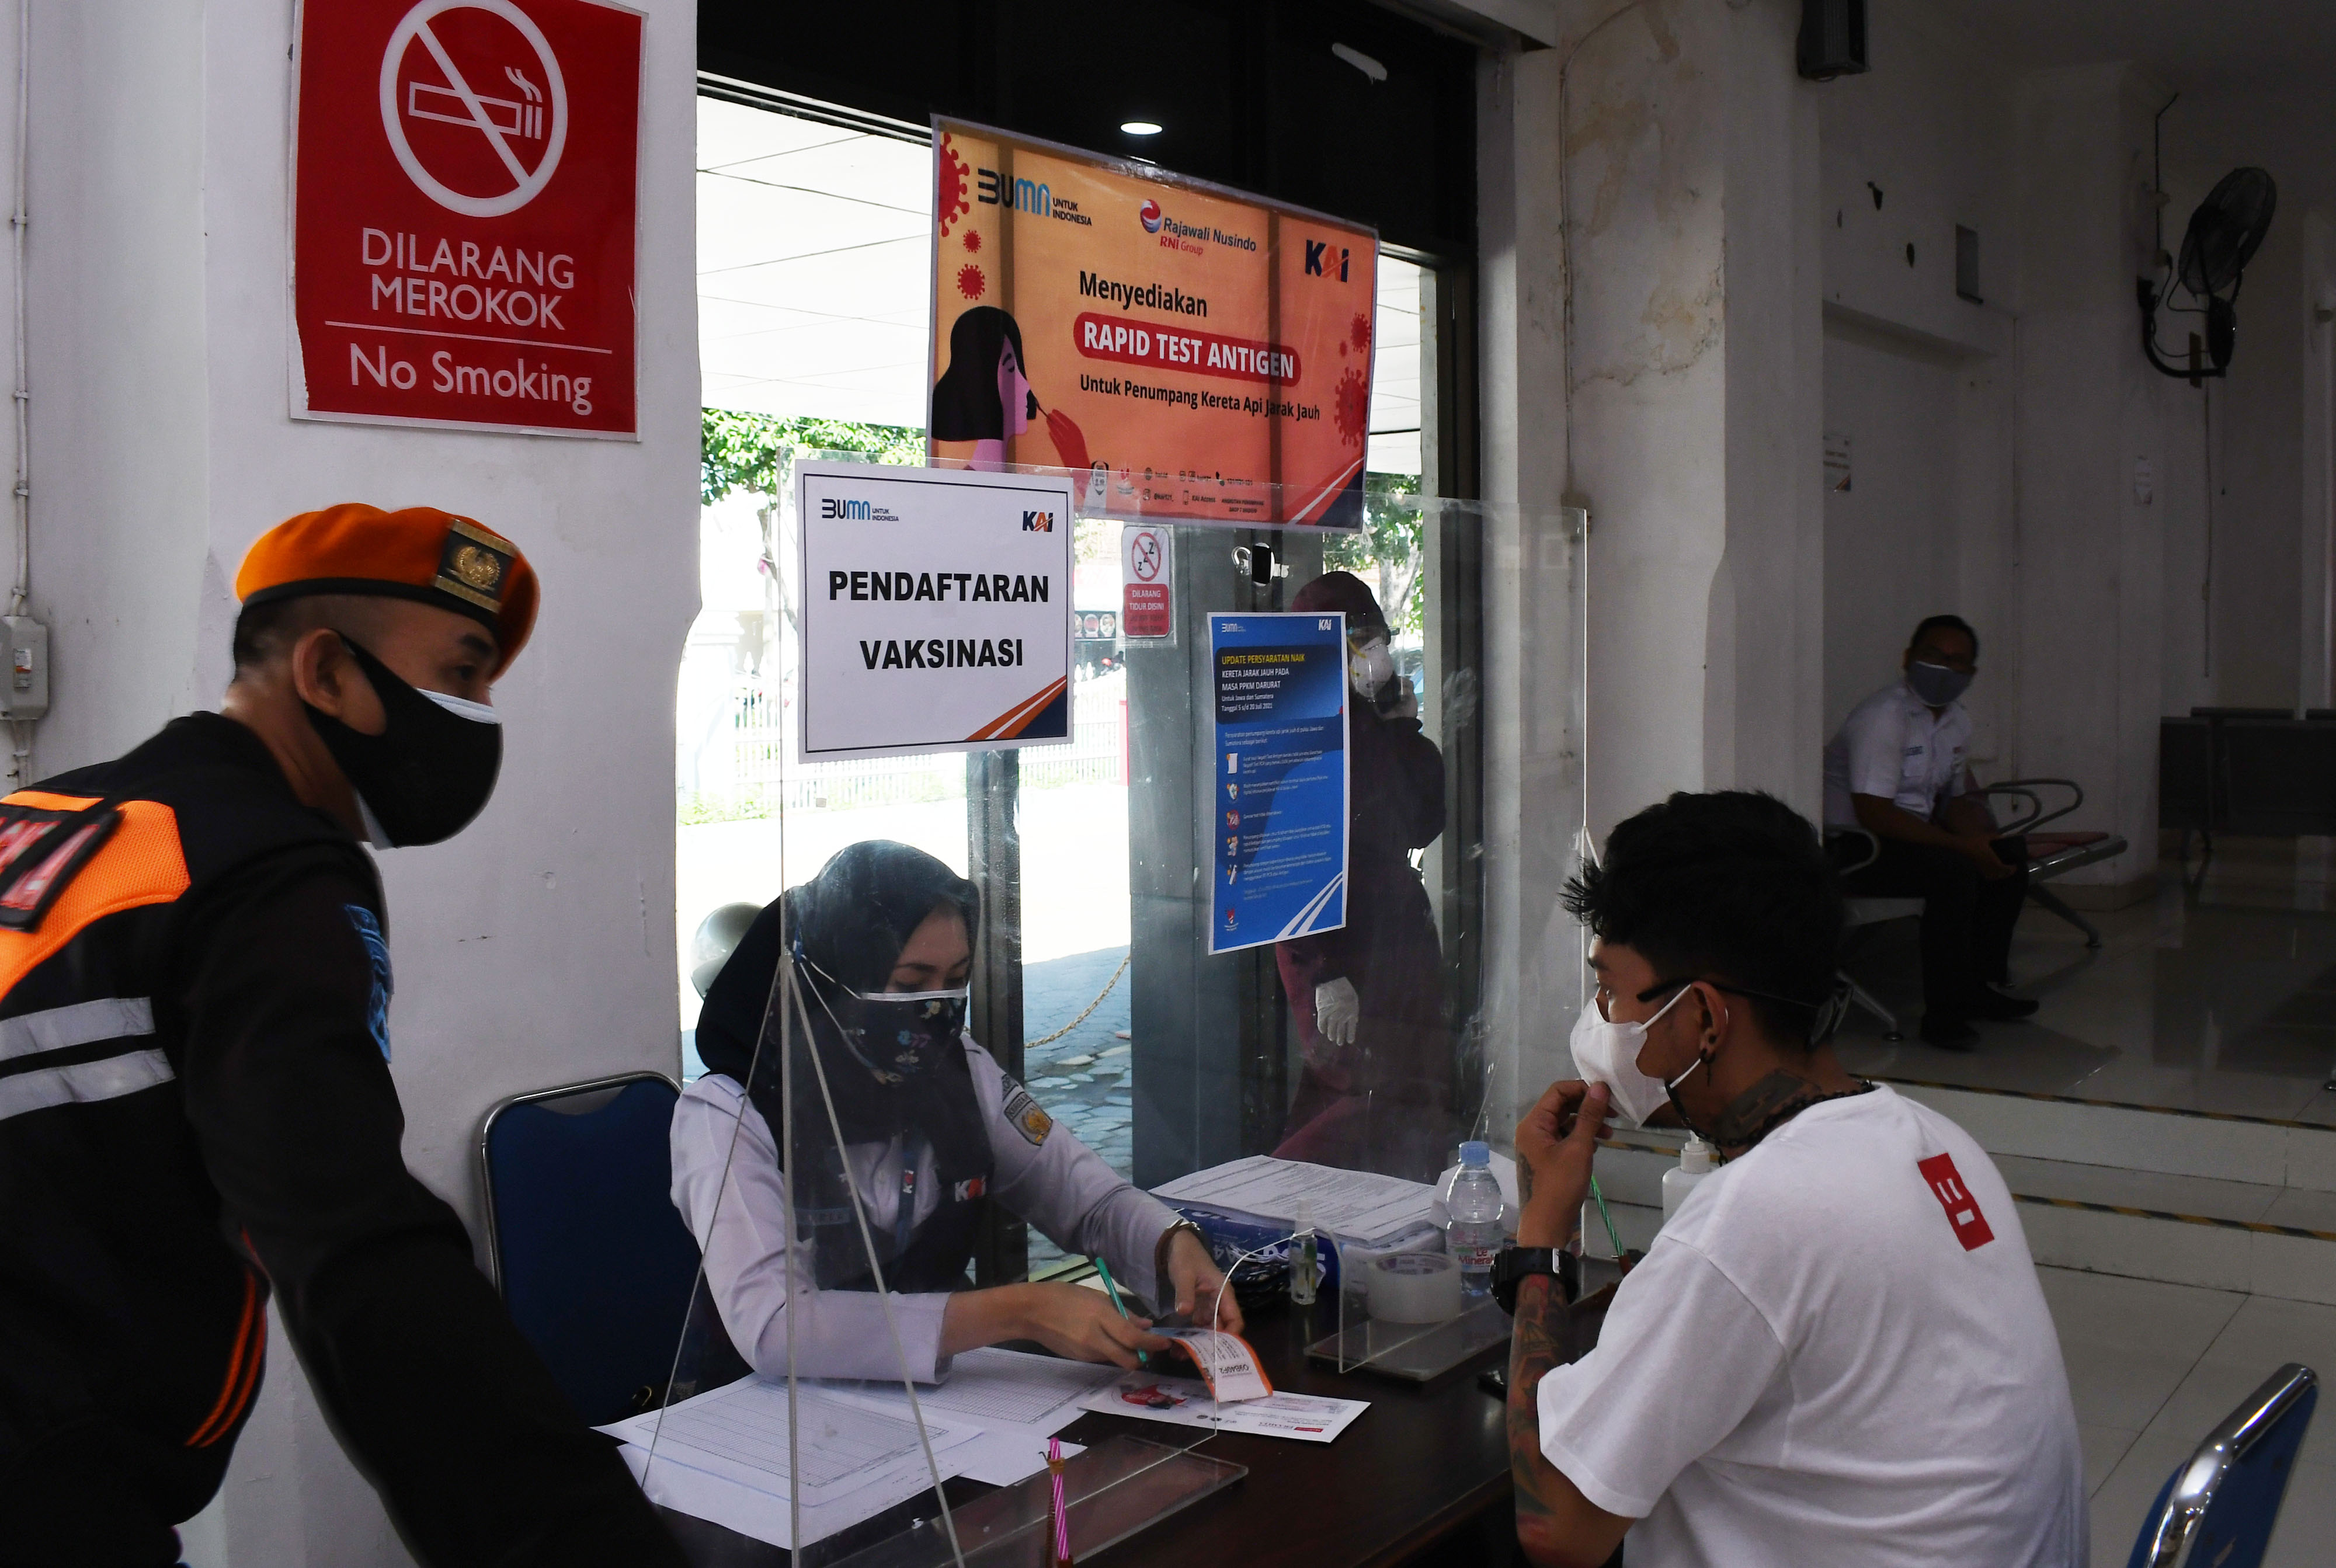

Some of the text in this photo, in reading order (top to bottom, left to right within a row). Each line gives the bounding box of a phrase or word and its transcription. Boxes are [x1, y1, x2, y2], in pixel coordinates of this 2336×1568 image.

[978, 168, 1050, 217] BUMN
[1052, 197, 1078, 211] UNTUK
[1052, 209, 1092, 226] INDONESIA
[1163, 217, 1257, 252] Rajawali Nusindo
[361, 227, 575, 290] DILARANG
[1181, 241, 1204, 256] Group
[1305, 239, 1349, 283] KAI
[371, 273, 565, 331] MEROKOK
[1079, 270, 1208, 317] Menyediakan
[1083, 321, 1294, 379] RAPID TEST ANTIGEN
[350, 343, 593, 416] No Smoking
[1080, 374, 1320, 420] Untuk Penumpang Kereta Api Jarak Jauh
[822, 499, 871, 520] BUMN
[1022, 510, 1054, 532] KAI
[828, 570, 1049, 603] PENDAFTARAN
[1132, 590, 1161, 598] DILARANG
[1148, 602, 1164, 610] DISINI
[1318, 619, 1332, 631] KAI
[859, 638, 1023, 670] VAKSINASI
[1222, 653, 1305, 665] UPDATE PERSYARATAN NAIK
[1222, 670, 1242, 678] KERETA
[1242, 669, 1259, 677] JARAK
[1260, 668, 1274, 676] JAUH
[1222, 680, 1281, 691] MASA PPKM DARURAT
[1458, 1254, 1494, 1265] Mineral
[1476, 1247, 1487, 1257] Le
